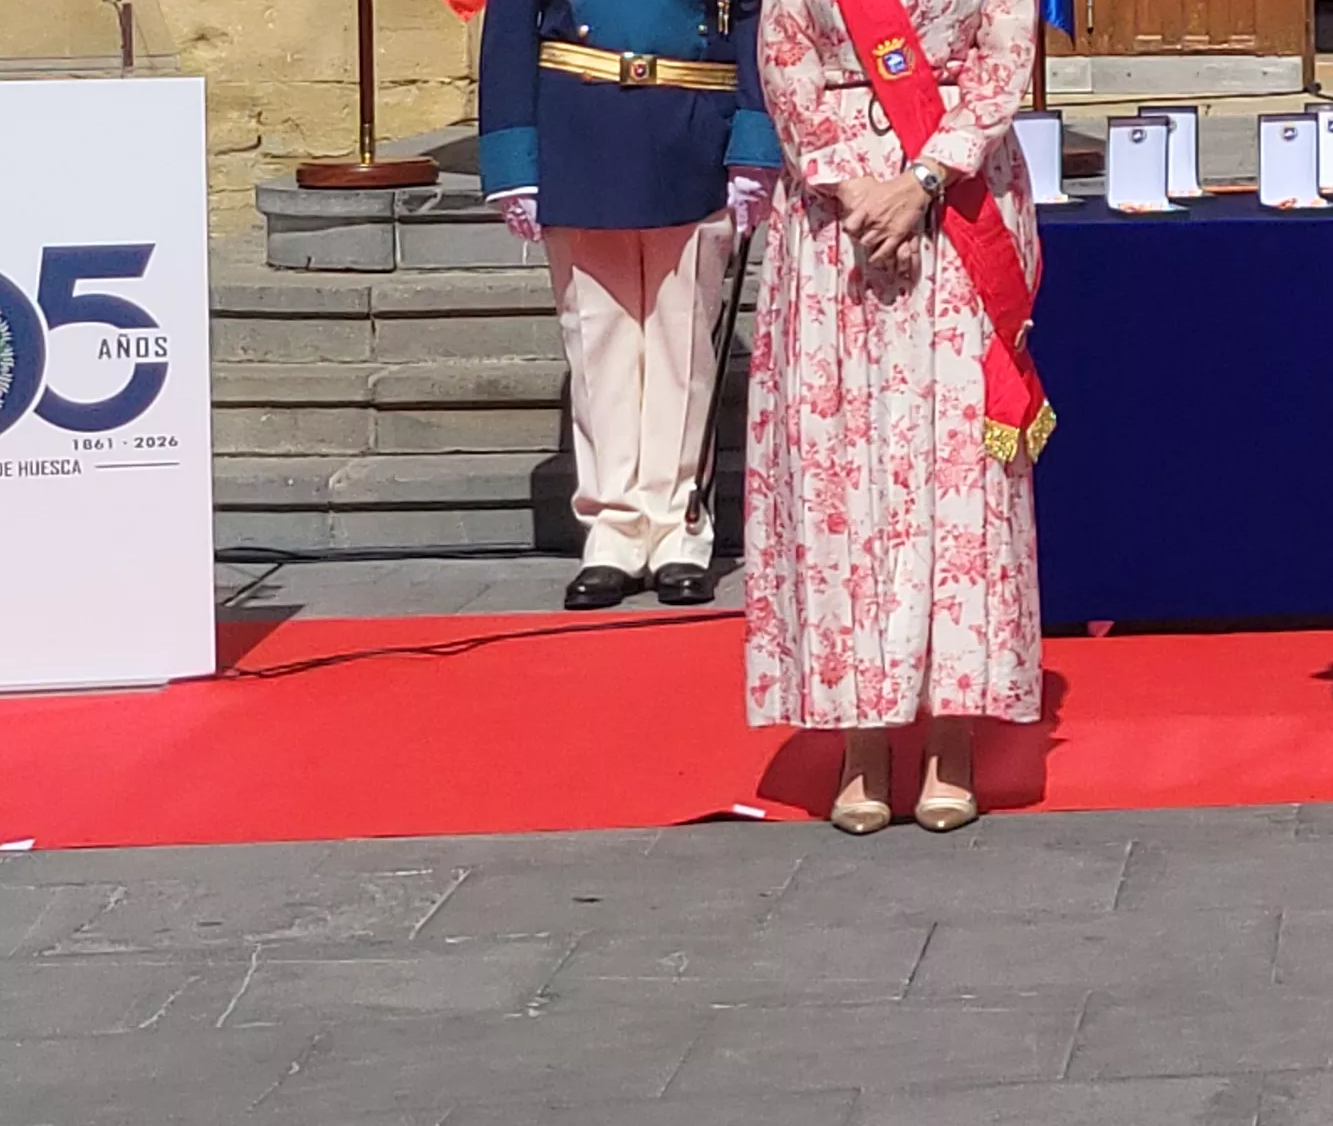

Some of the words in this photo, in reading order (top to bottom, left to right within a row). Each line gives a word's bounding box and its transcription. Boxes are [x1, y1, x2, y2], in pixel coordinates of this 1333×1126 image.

[98, 334, 168, 360] AÑOS
[72, 438, 114, 451] 1861
[133, 436, 179, 449] 2026
[19, 459, 82, 478] HUESCA
